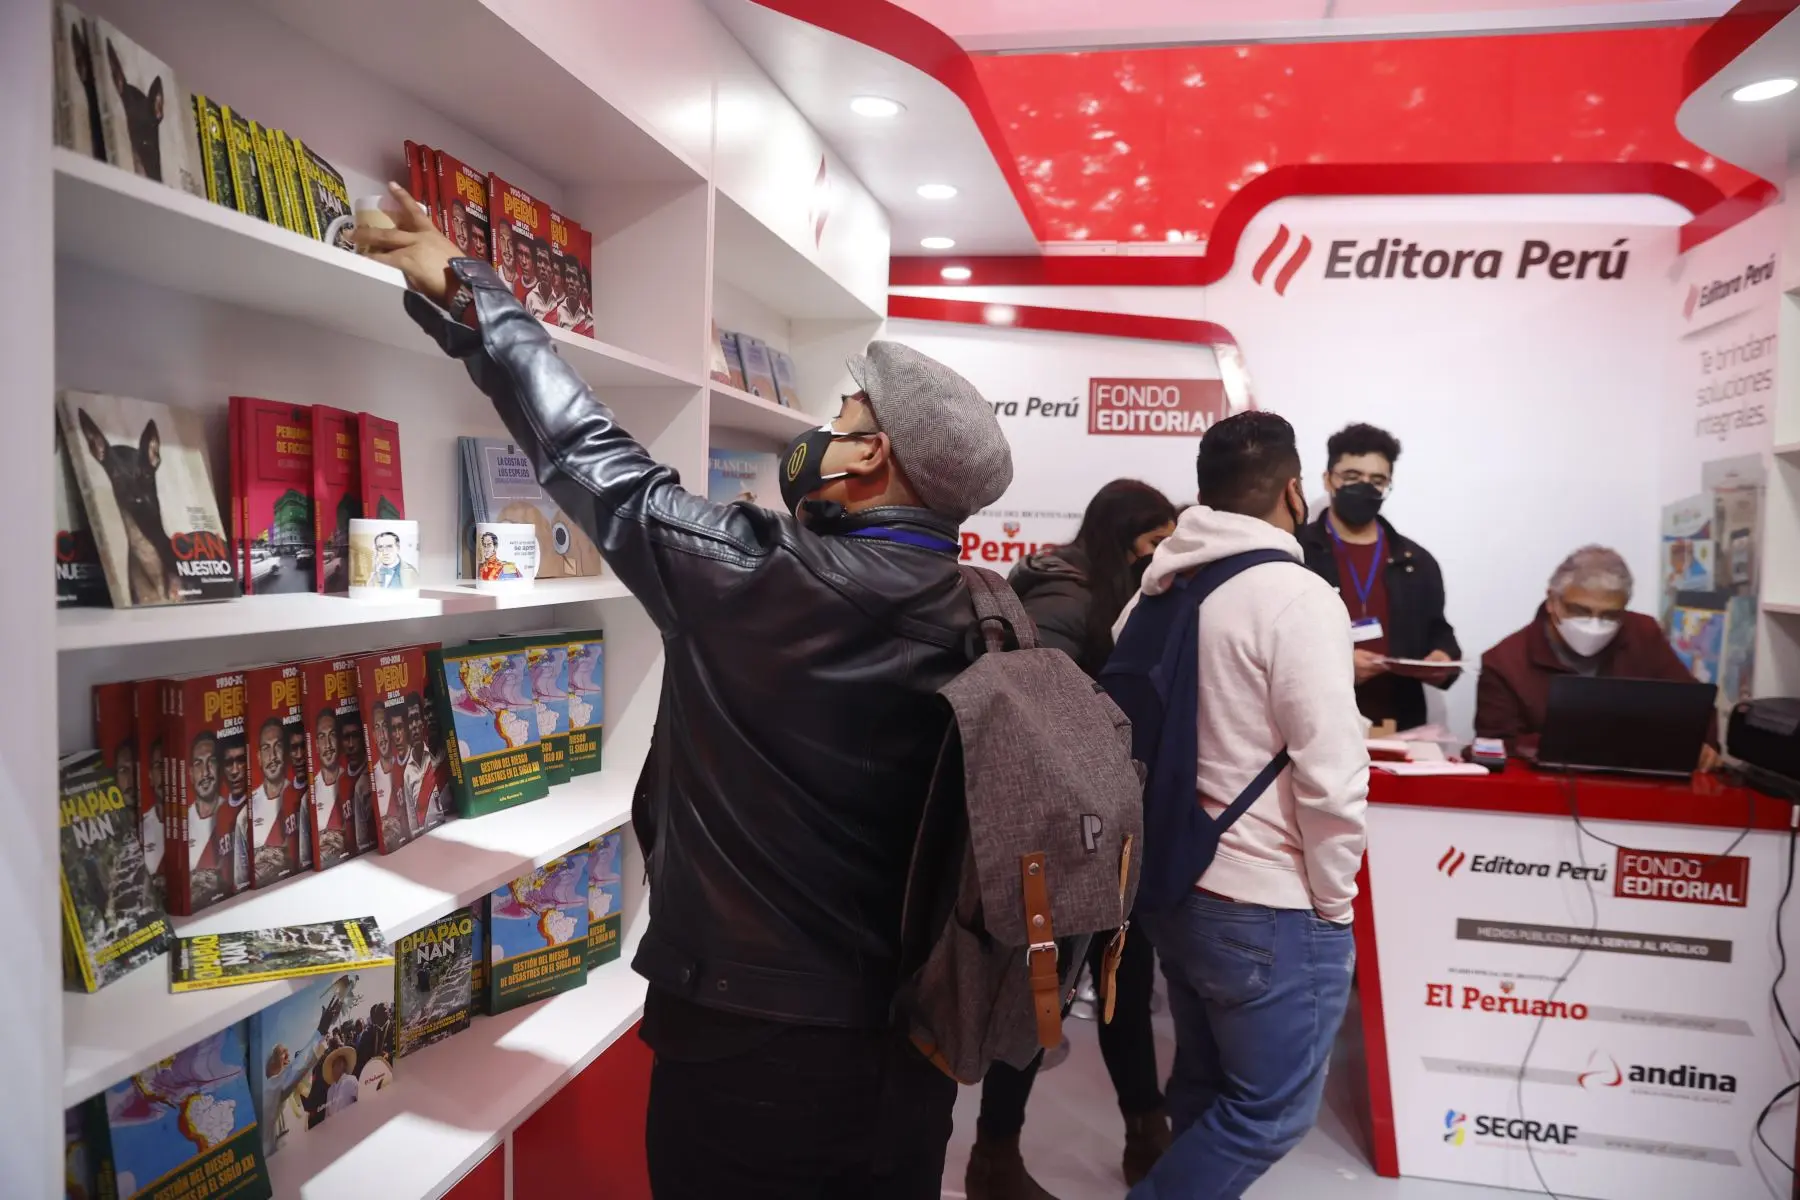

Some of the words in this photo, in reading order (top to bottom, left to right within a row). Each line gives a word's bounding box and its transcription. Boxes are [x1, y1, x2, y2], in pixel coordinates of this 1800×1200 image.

[503, 192, 538, 229] PERÚ
[1324, 238, 1502, 280] Editora
[1516, 237, 1629, 280] Perú
[1699, 275, 1742, 308] Editora
[1744, 253, 1775, 290] Perú
[1025, 396, 1080, 417] Perú
[1097, 384, 1180, 408] FONDO
[171, 531, 227, 561] CAN
[176, 560, 232, 577] NUESTRO
[374, 656, 409, 694] PERÚ
[479, 769, 506, 786] DESASTRES
[480, 758, 502, 774] GESTIÓN
[511, 752, 528, 766] RIESGO
[59, 785, 126, 828] HAPAQ
[72, 813, 115, 849] ÑAN
[1470, 855, 1551, 878] Editora
[1556, 862, 1608, 883] Perú
[1623, 854, 1702, 880] FONDO
[1623, 875, 1740, 903] EDITORIAL
[401, 918, 472, 953] QHAPAQ
[1601, 936, 1640, 949] SERVIR
[417, 937, 455, 965] ÑAN
[513, 955, 538, 973] GESTIÓN
[538, 954, 548, 966] DEL
[548, 948, 569, 964] RIESGO
[508, 967, 541, 987] DESASTRES
[555, 958, 572, 972] SIGLO
[1425, 981, 1453, 1009] El
[1462, 986, 1588, 1021] Peruano
[1628, 1062, 1738, 1094] andina
[1475, 1114, 1578, 1145] SEGRAF
[203, 1148, 235, 1178] RIESGO
